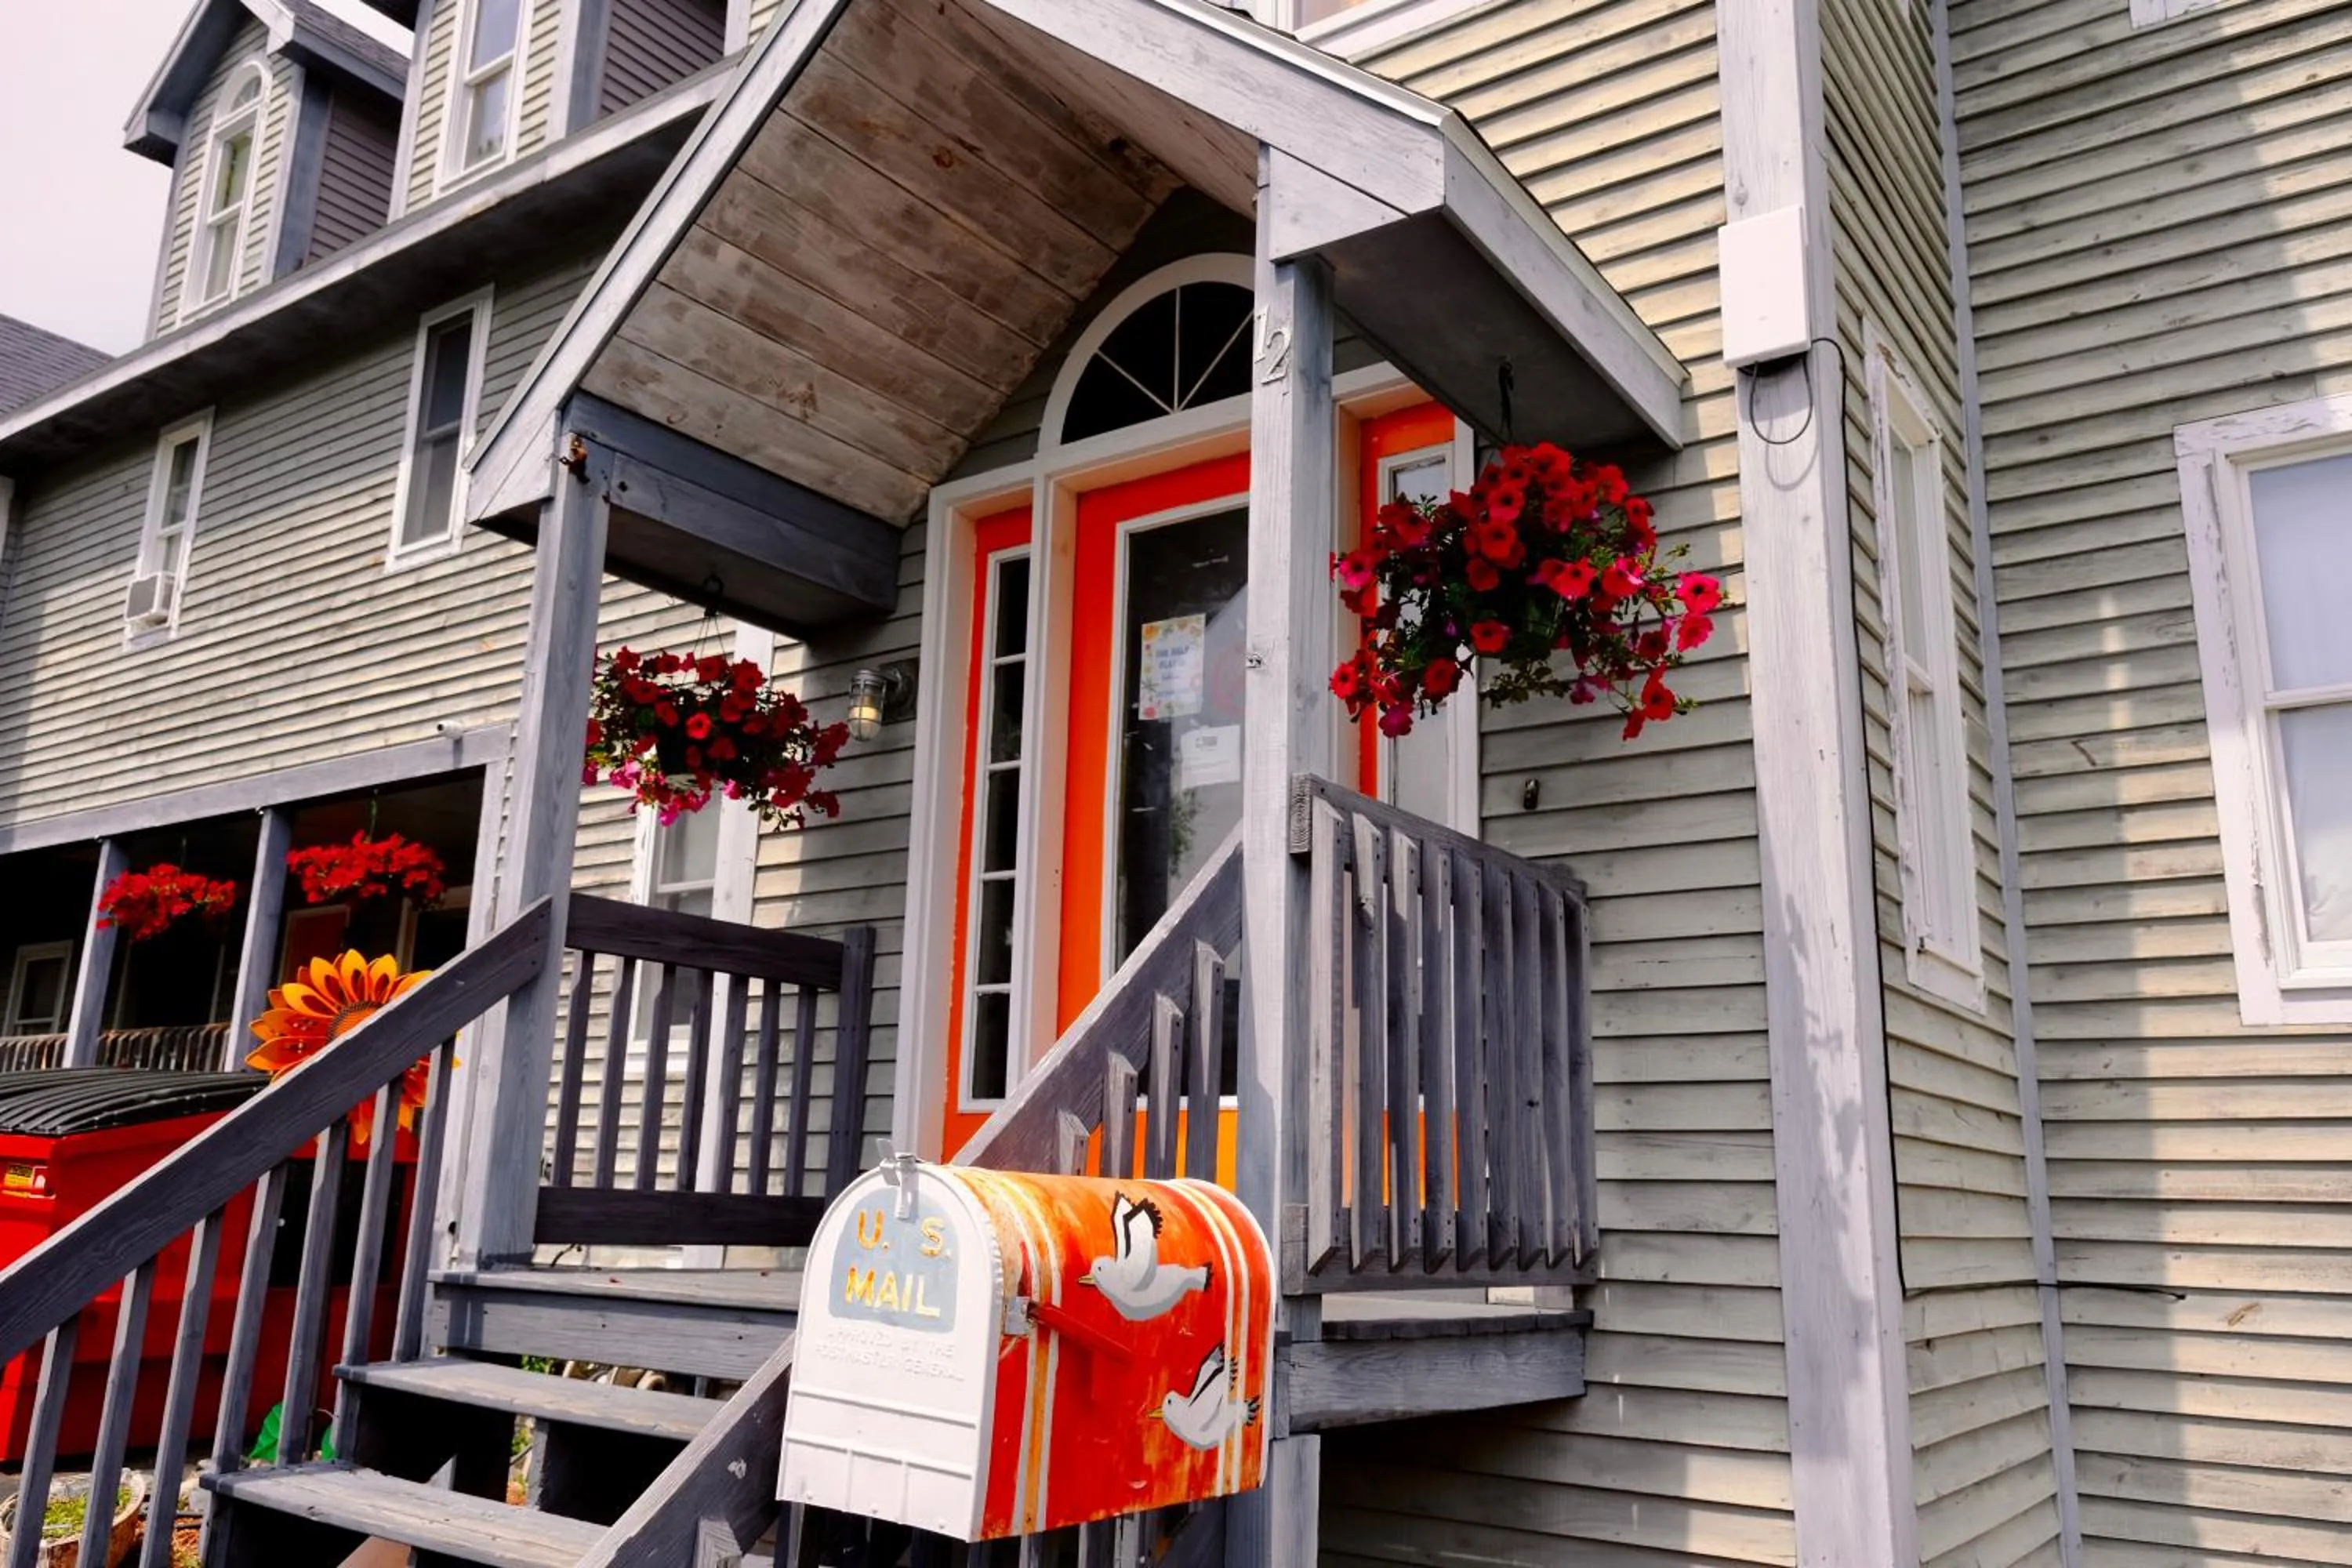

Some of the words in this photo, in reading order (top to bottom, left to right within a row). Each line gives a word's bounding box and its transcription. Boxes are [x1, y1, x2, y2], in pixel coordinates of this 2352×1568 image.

[1254, 304, 1292, 387] 12
[858, 1210, 889, 1252] U.
[846, 1265, 941, 1318] MAIL
